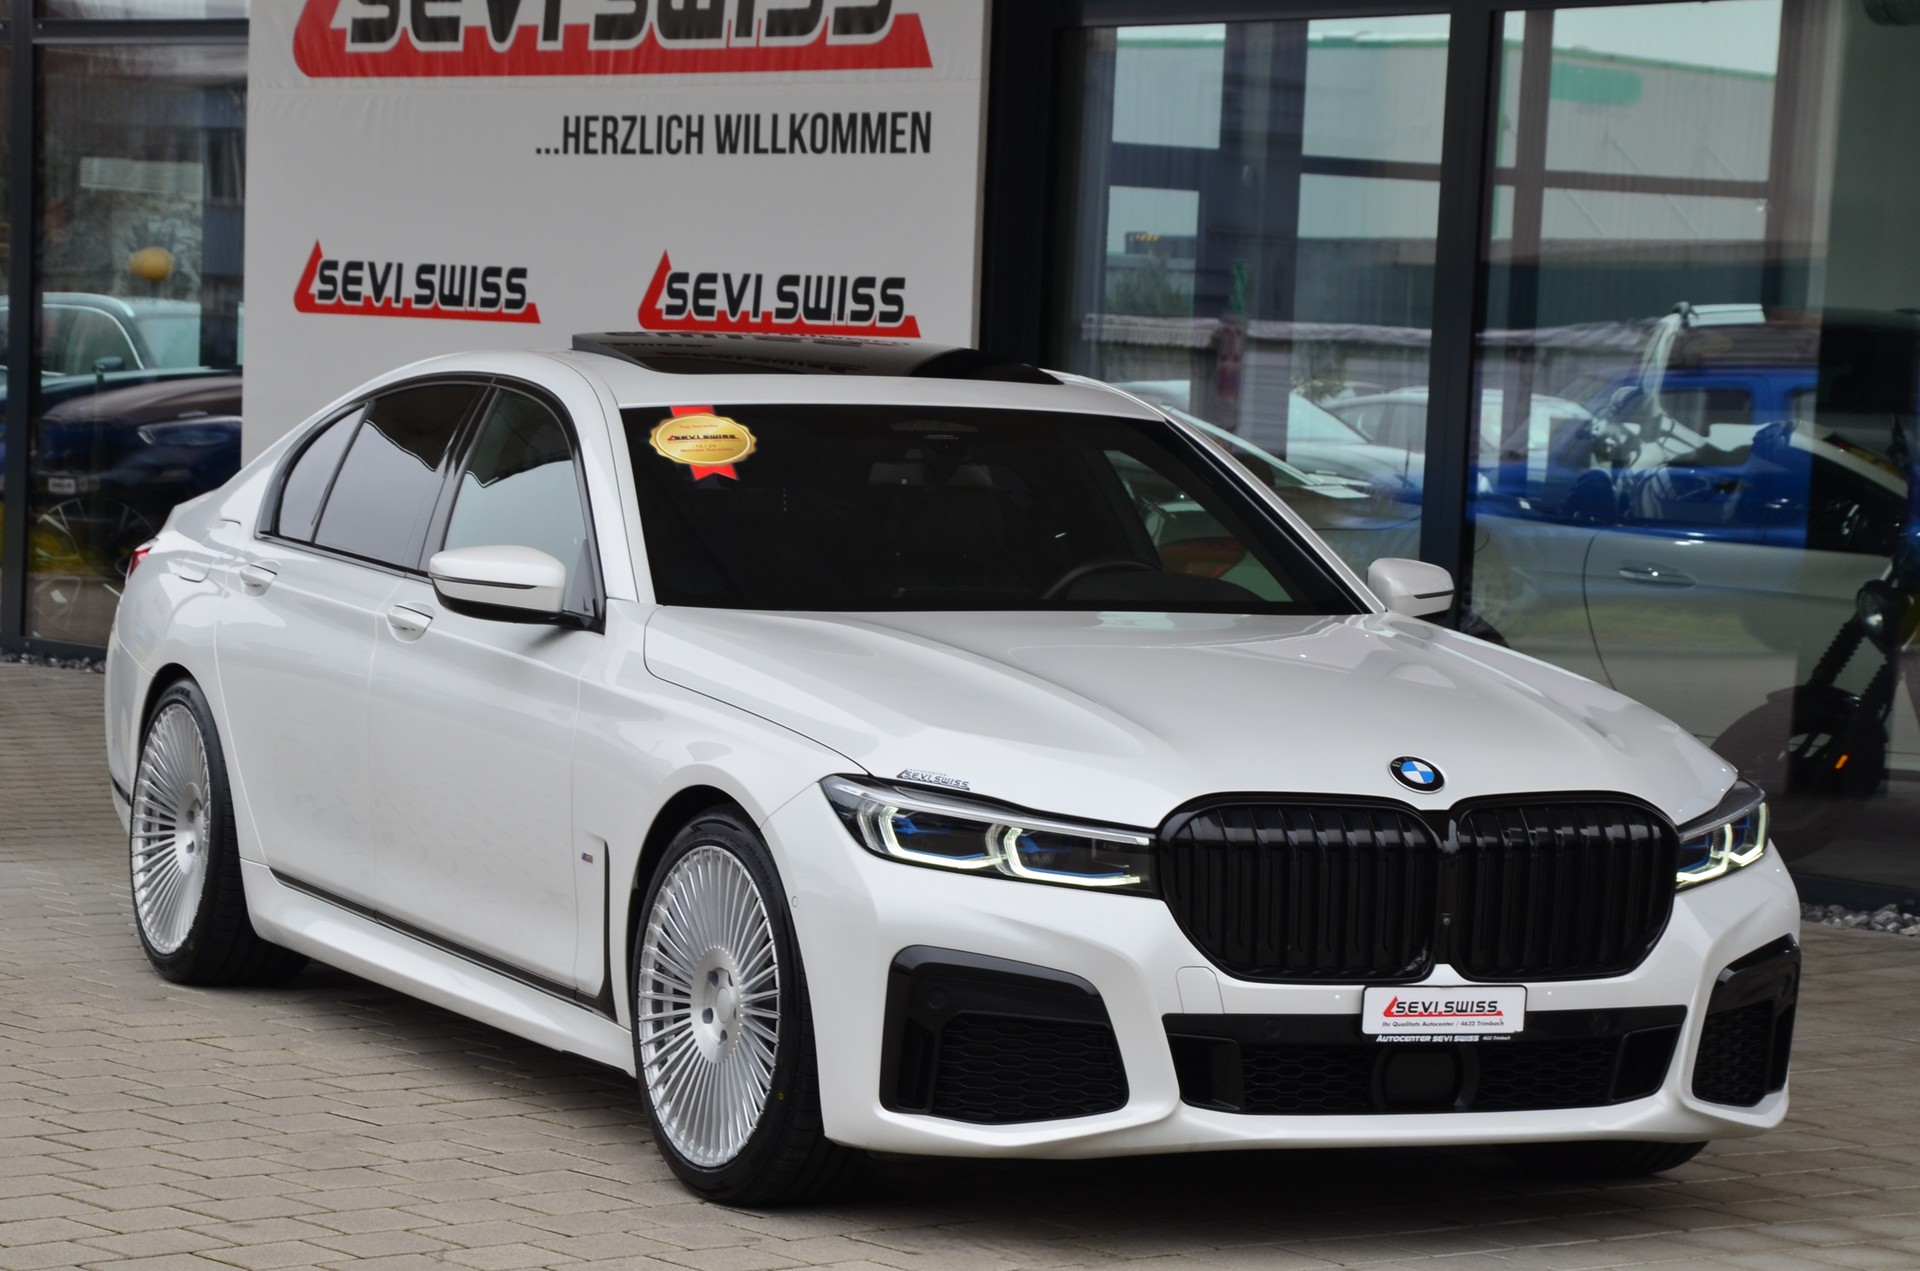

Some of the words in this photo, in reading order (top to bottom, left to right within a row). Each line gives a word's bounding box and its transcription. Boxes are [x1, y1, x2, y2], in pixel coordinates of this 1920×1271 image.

[536, 114, 704, 155] ...HERZLICH
[714, 111, 932, 155] WILLKOMMEN
[317, 260, 404, 304] SEVI
[413, 263, 528, 310] SWISS
[665, 271, 764, 319] SEVI
[773, 274, 906, 323] SWISS
[904, 771, 932, 781] SEVI
[933, 775, 970, 788] SWISS
[1395, 1001, 1439, 1013] SEVI
[1443, 1000, 1498, 1013] SWISS
